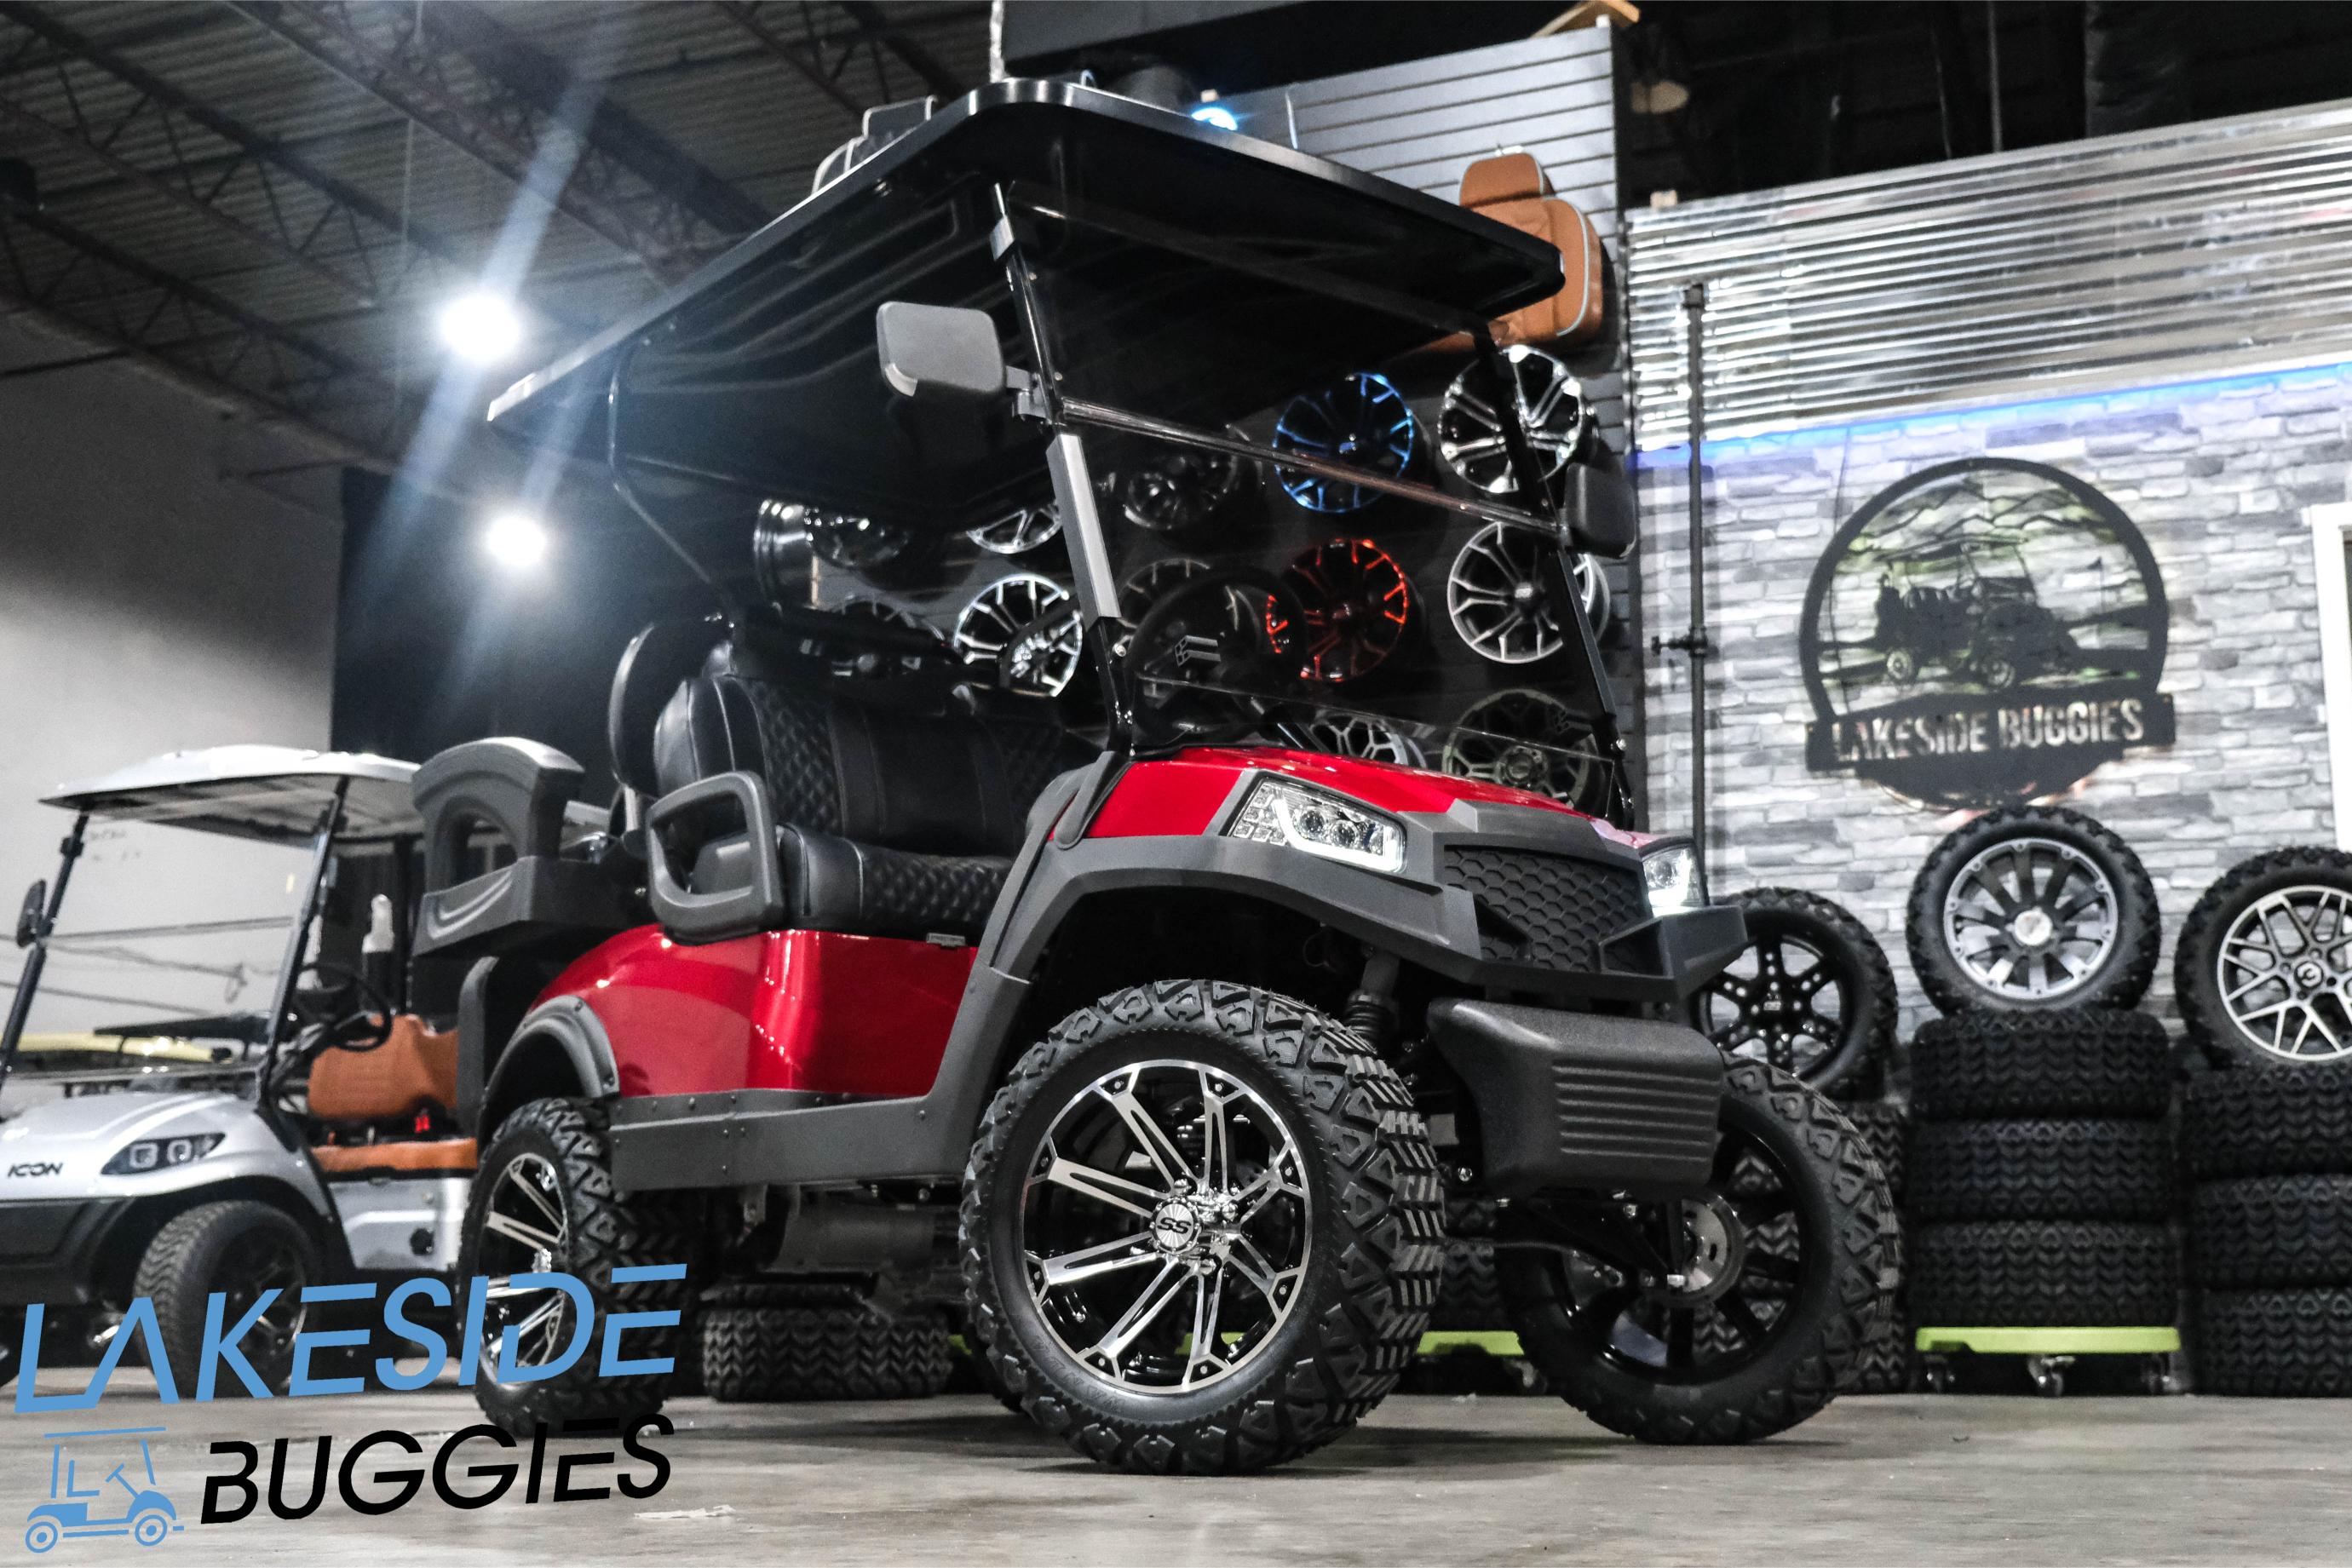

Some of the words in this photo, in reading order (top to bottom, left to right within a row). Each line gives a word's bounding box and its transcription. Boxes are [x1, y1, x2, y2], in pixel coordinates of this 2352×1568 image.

[1832, 712, 1989, 761] LAKESIDE
[1998, 698, 2144, 748] BUGGIES
[8, 1163, 63, 1177] ICON
[1157, 1217, 1192, 1234] SS
